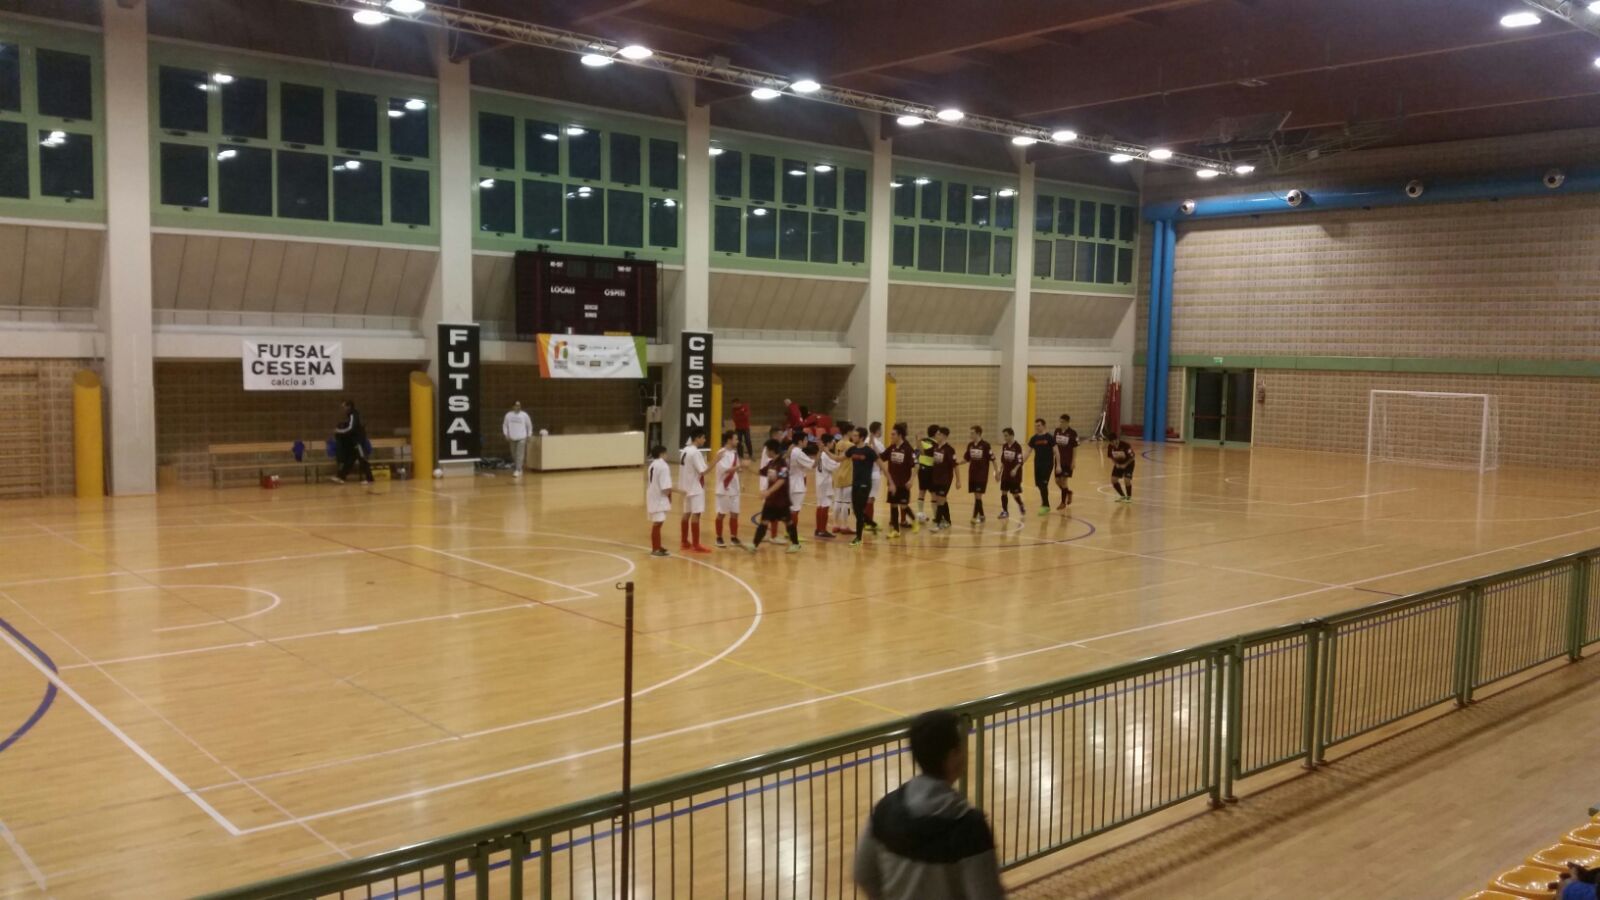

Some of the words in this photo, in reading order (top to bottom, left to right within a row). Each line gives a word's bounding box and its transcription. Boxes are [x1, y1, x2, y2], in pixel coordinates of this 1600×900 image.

[257, 343, 331, 359] FUTSAL
[251, 360, 336, 376] CESENA
[271, 377, 299, 386] calcio
[309, 377, 315, 386] 5
[446, 329, 472, 456] FUTSAL
